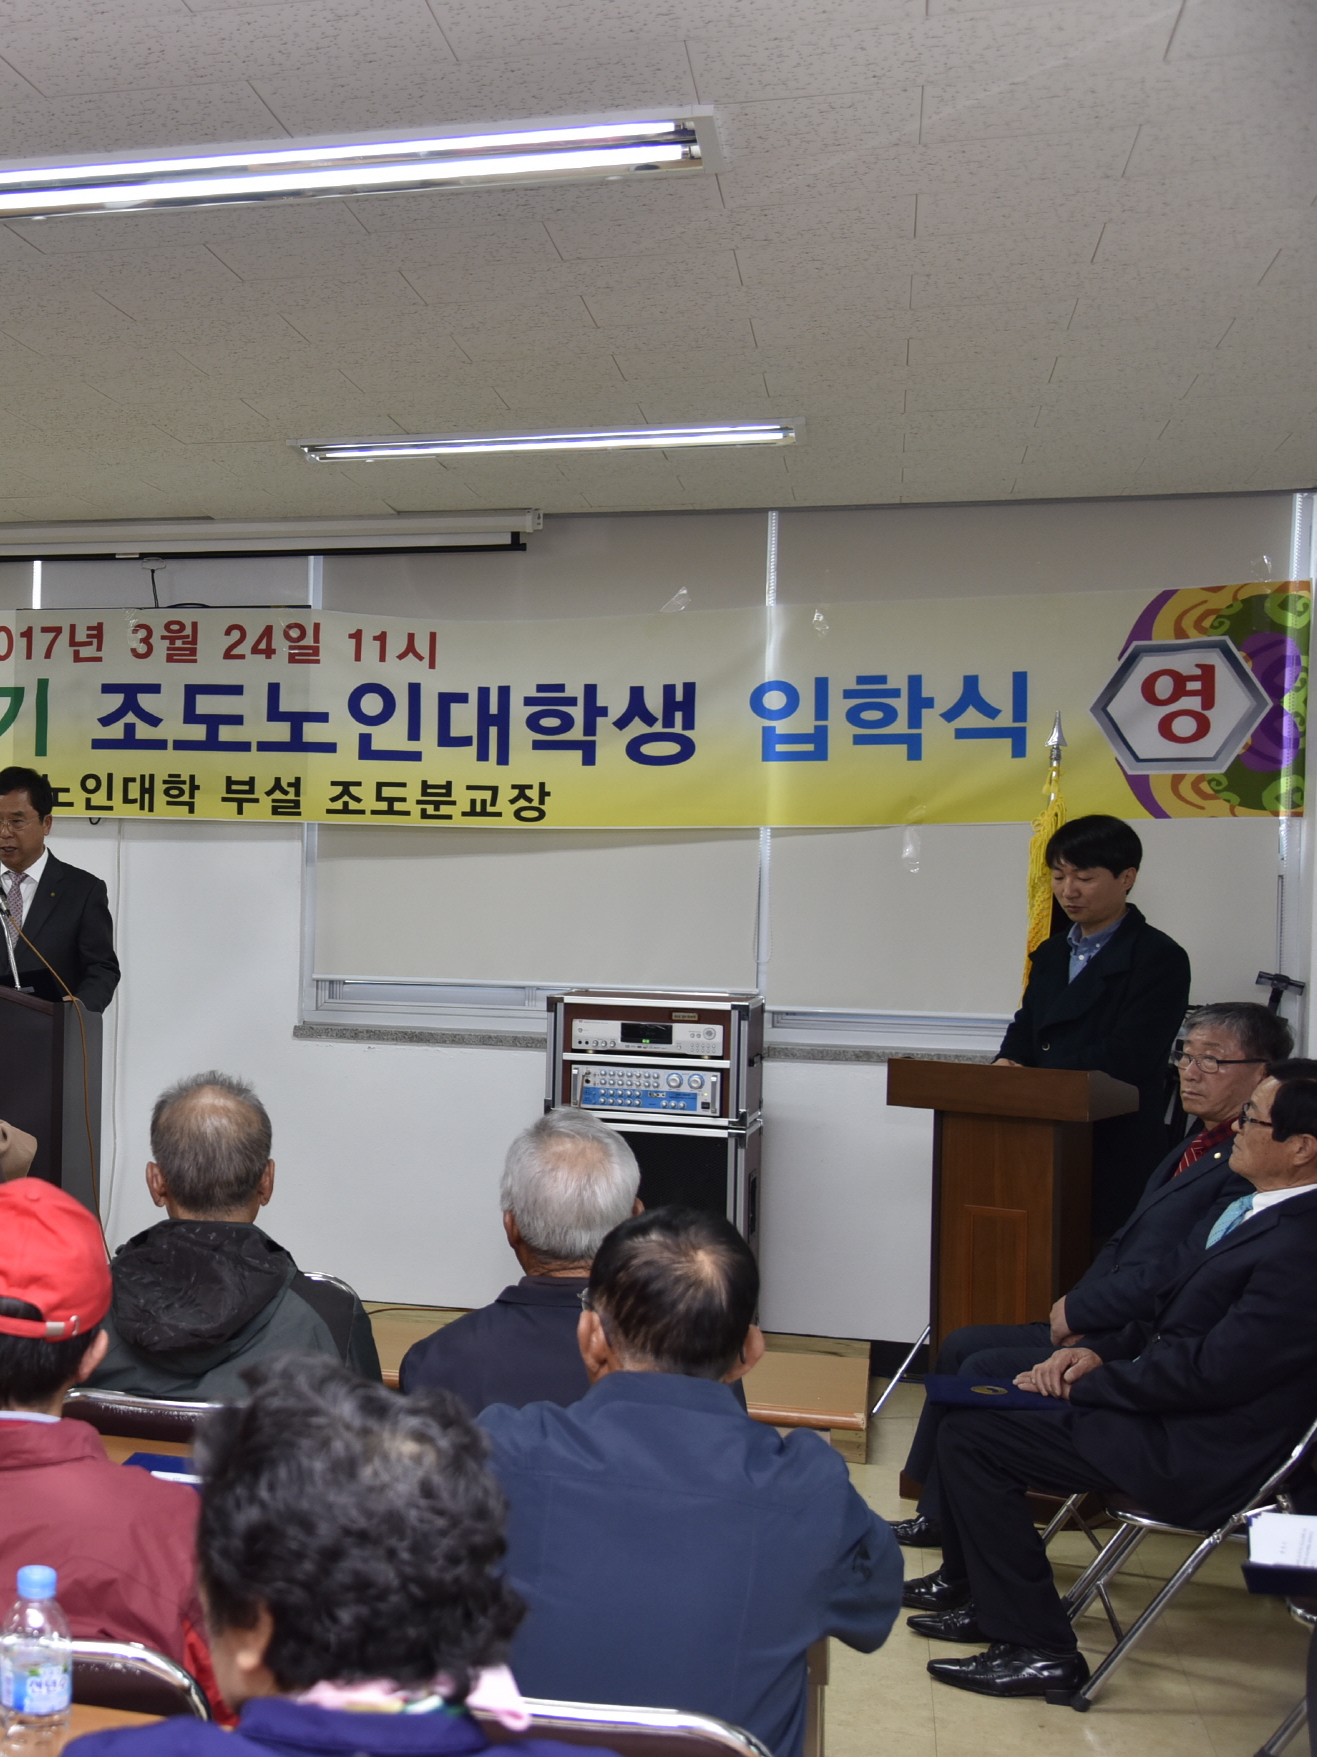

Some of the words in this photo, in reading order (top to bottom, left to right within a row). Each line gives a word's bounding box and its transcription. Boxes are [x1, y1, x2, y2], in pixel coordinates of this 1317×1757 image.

[130, 620, 198, 664] 3월
[222, 622, 321, 665] 24일
[347, 628, 438, 669] 11시
[90, 681, 697, 766] 조도노인대학생
[749, 671, 1028, 762] 입학식
[1140, 663, 1217, 744] 영
[221, 775, 302, 817] 부설
[326, 779, 551, 823] 조도분교장
